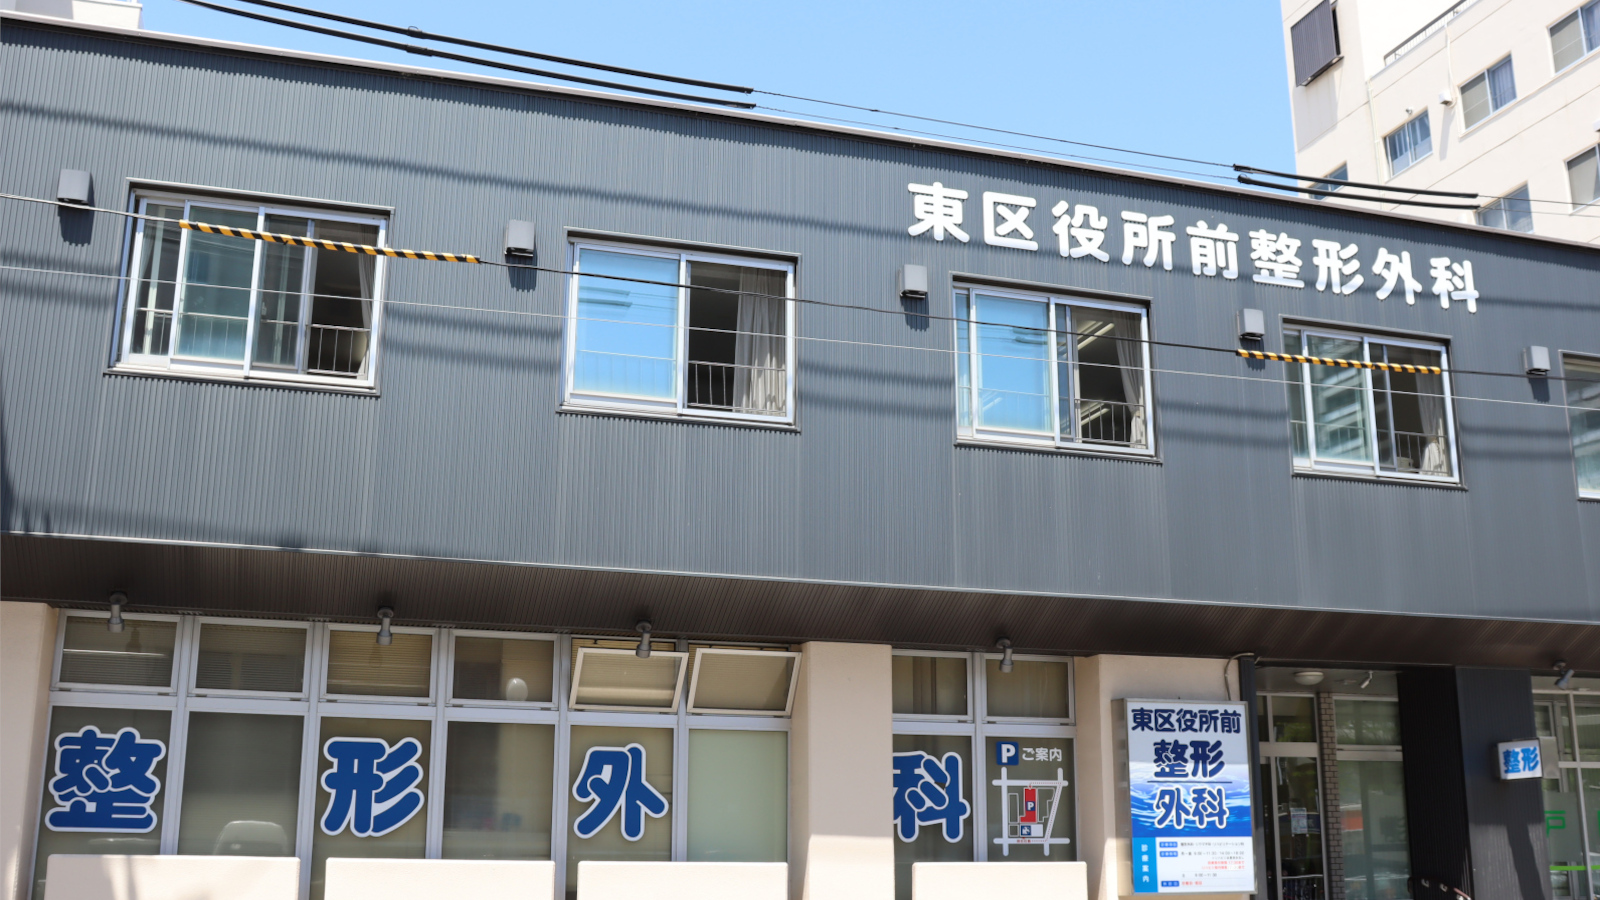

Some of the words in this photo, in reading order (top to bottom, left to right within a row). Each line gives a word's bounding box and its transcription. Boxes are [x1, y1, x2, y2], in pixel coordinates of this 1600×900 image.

[907, 181, 1480, 314] 東区役所前整形外科
[1131, 707, 1242, 734] 東区役所前
[1001, 744, 1016, 763] P
[1022, 747, 1063, 762] ご案内
[1153, 739, 1225, 778] 整形
[1502, 746, 1539, 774] 整形
[1153, 786, 1229, 829] 外科
